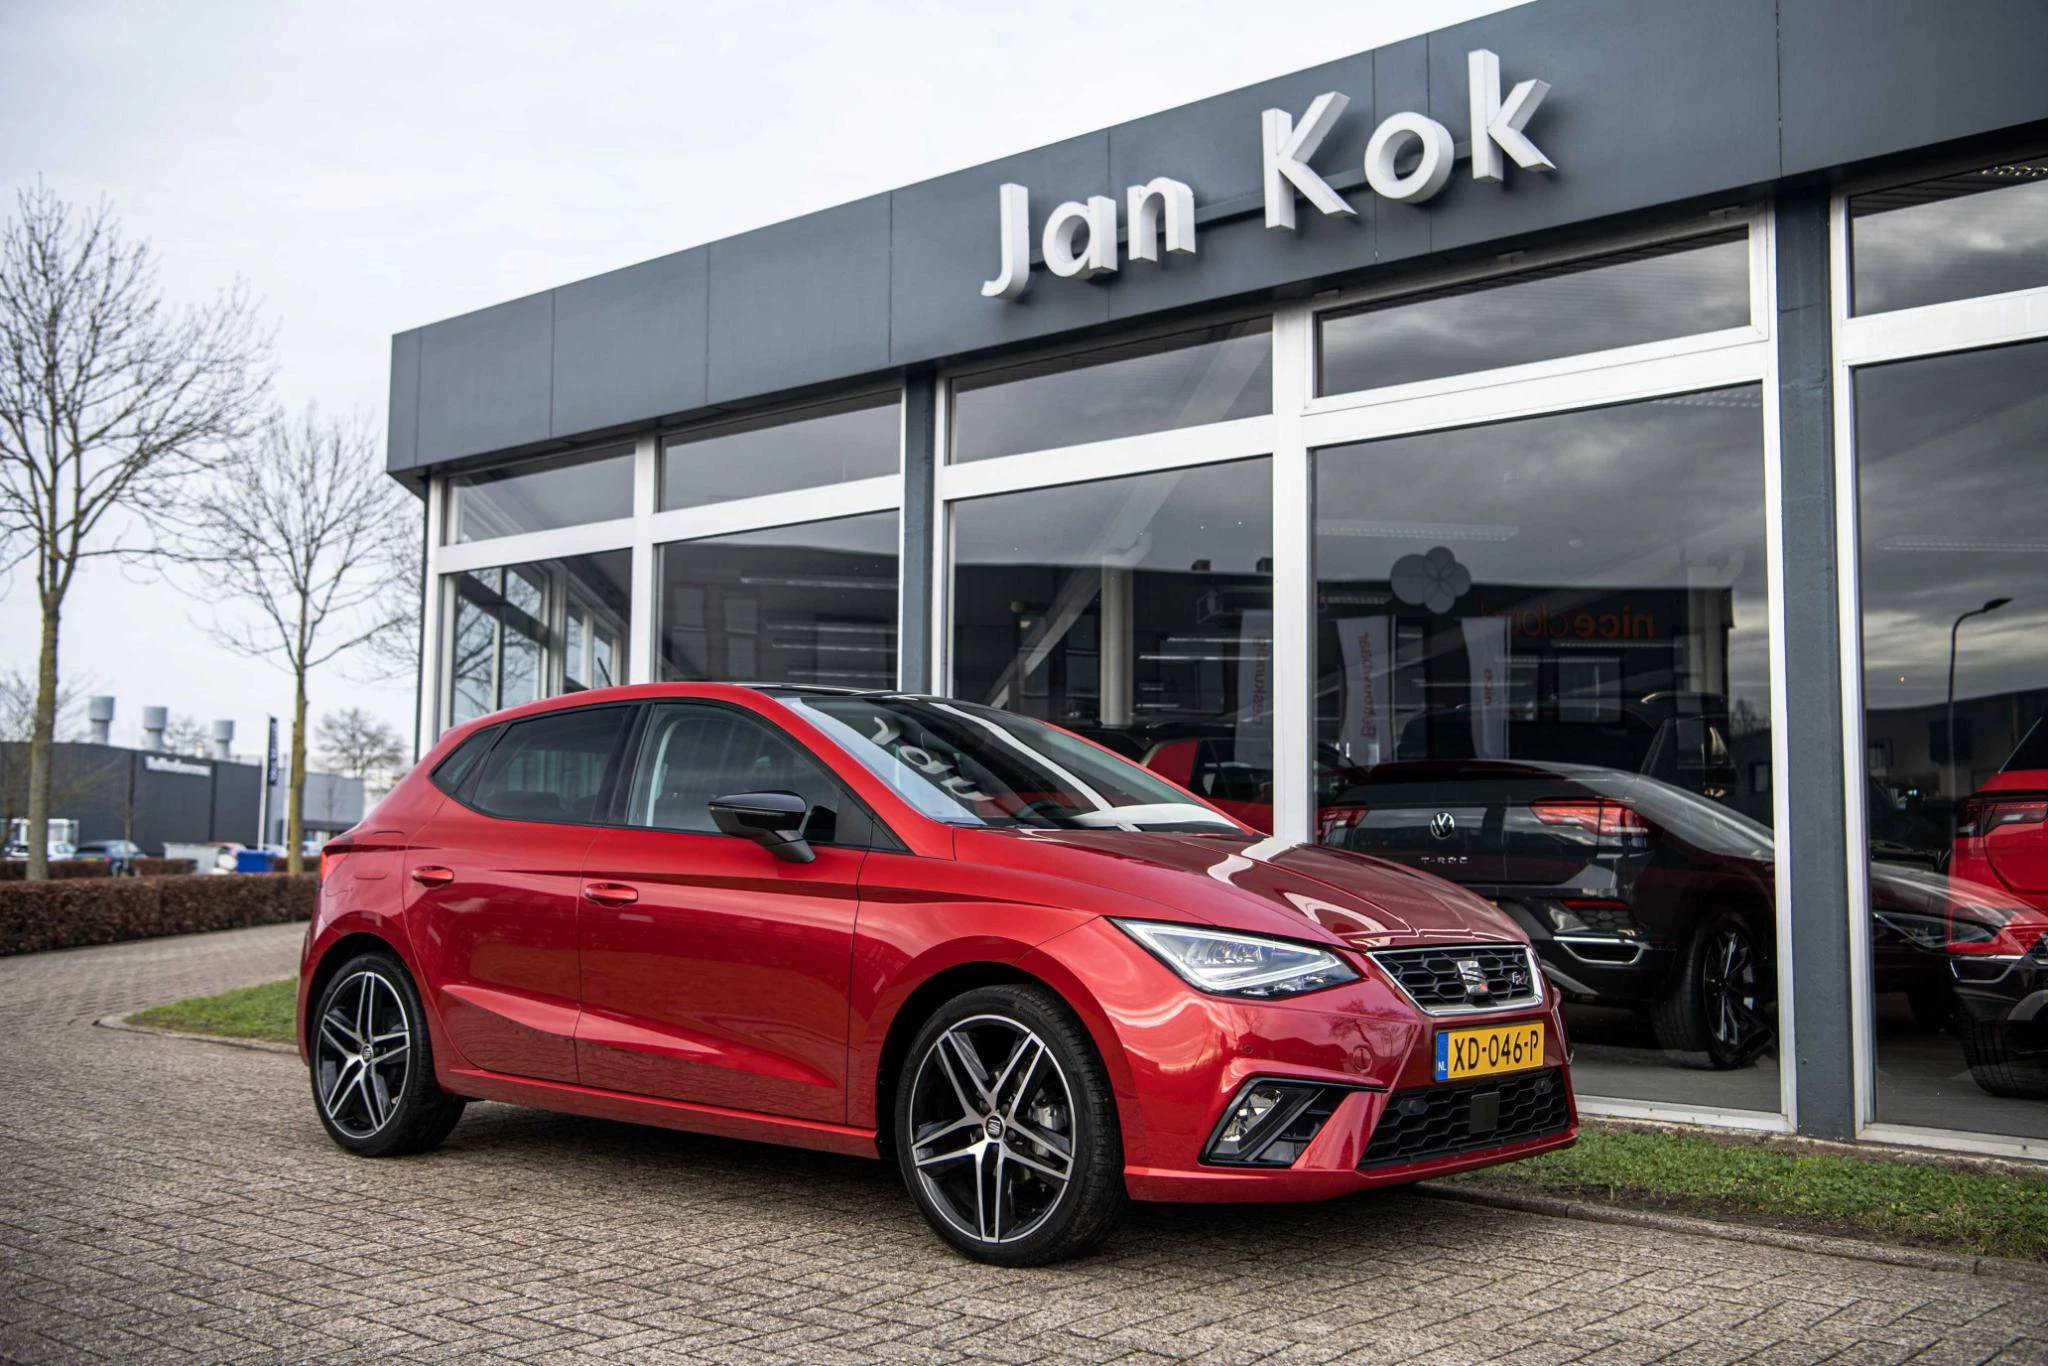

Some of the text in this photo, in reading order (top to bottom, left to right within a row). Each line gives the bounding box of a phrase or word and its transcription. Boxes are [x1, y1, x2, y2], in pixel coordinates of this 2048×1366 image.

[981, 48, 1557, 299] Jan Kok
[1437, 1061, 1447, 1072] NL
[1452, 1029, 1539, 1073] XD-046-P
